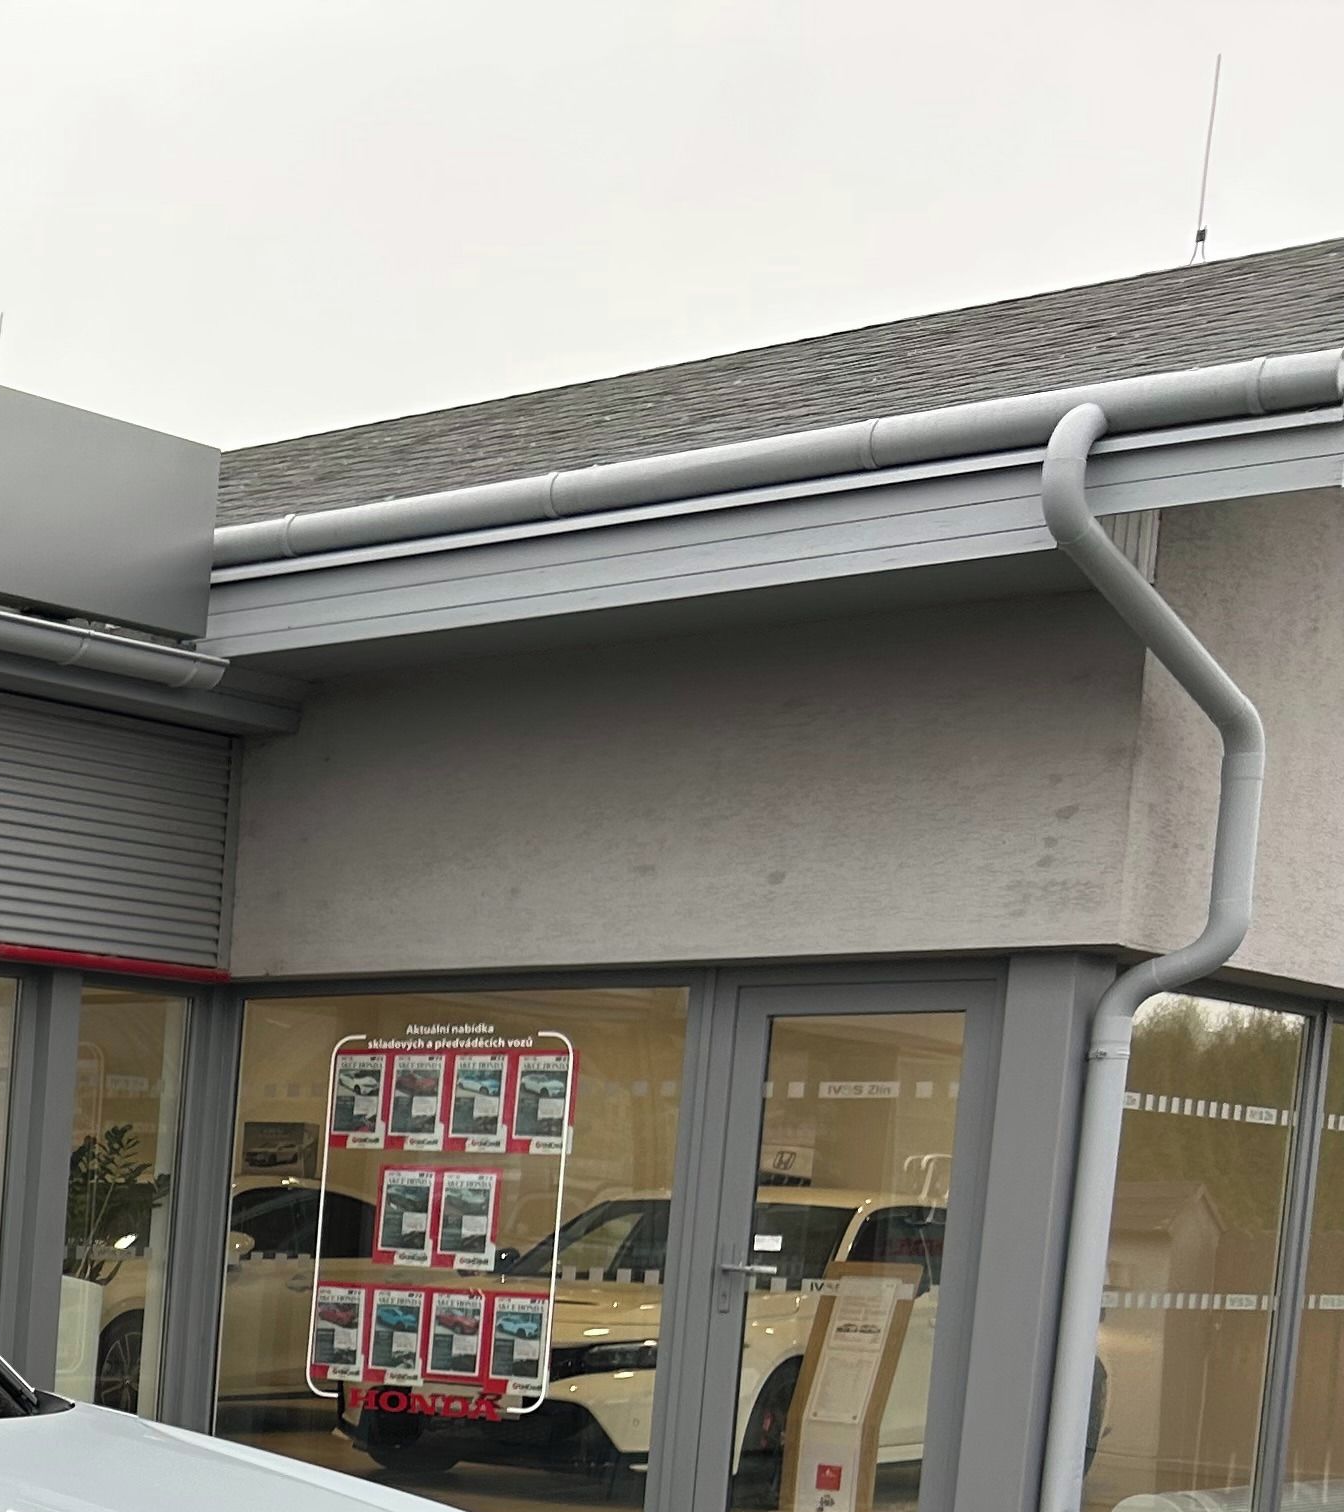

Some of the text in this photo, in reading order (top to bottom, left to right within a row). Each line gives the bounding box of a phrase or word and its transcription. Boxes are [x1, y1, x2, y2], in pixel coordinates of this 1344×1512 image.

[406, 1022, 494, 1035] Aktuální nabídka
[349, 1387, 501, 1421] HONDA
